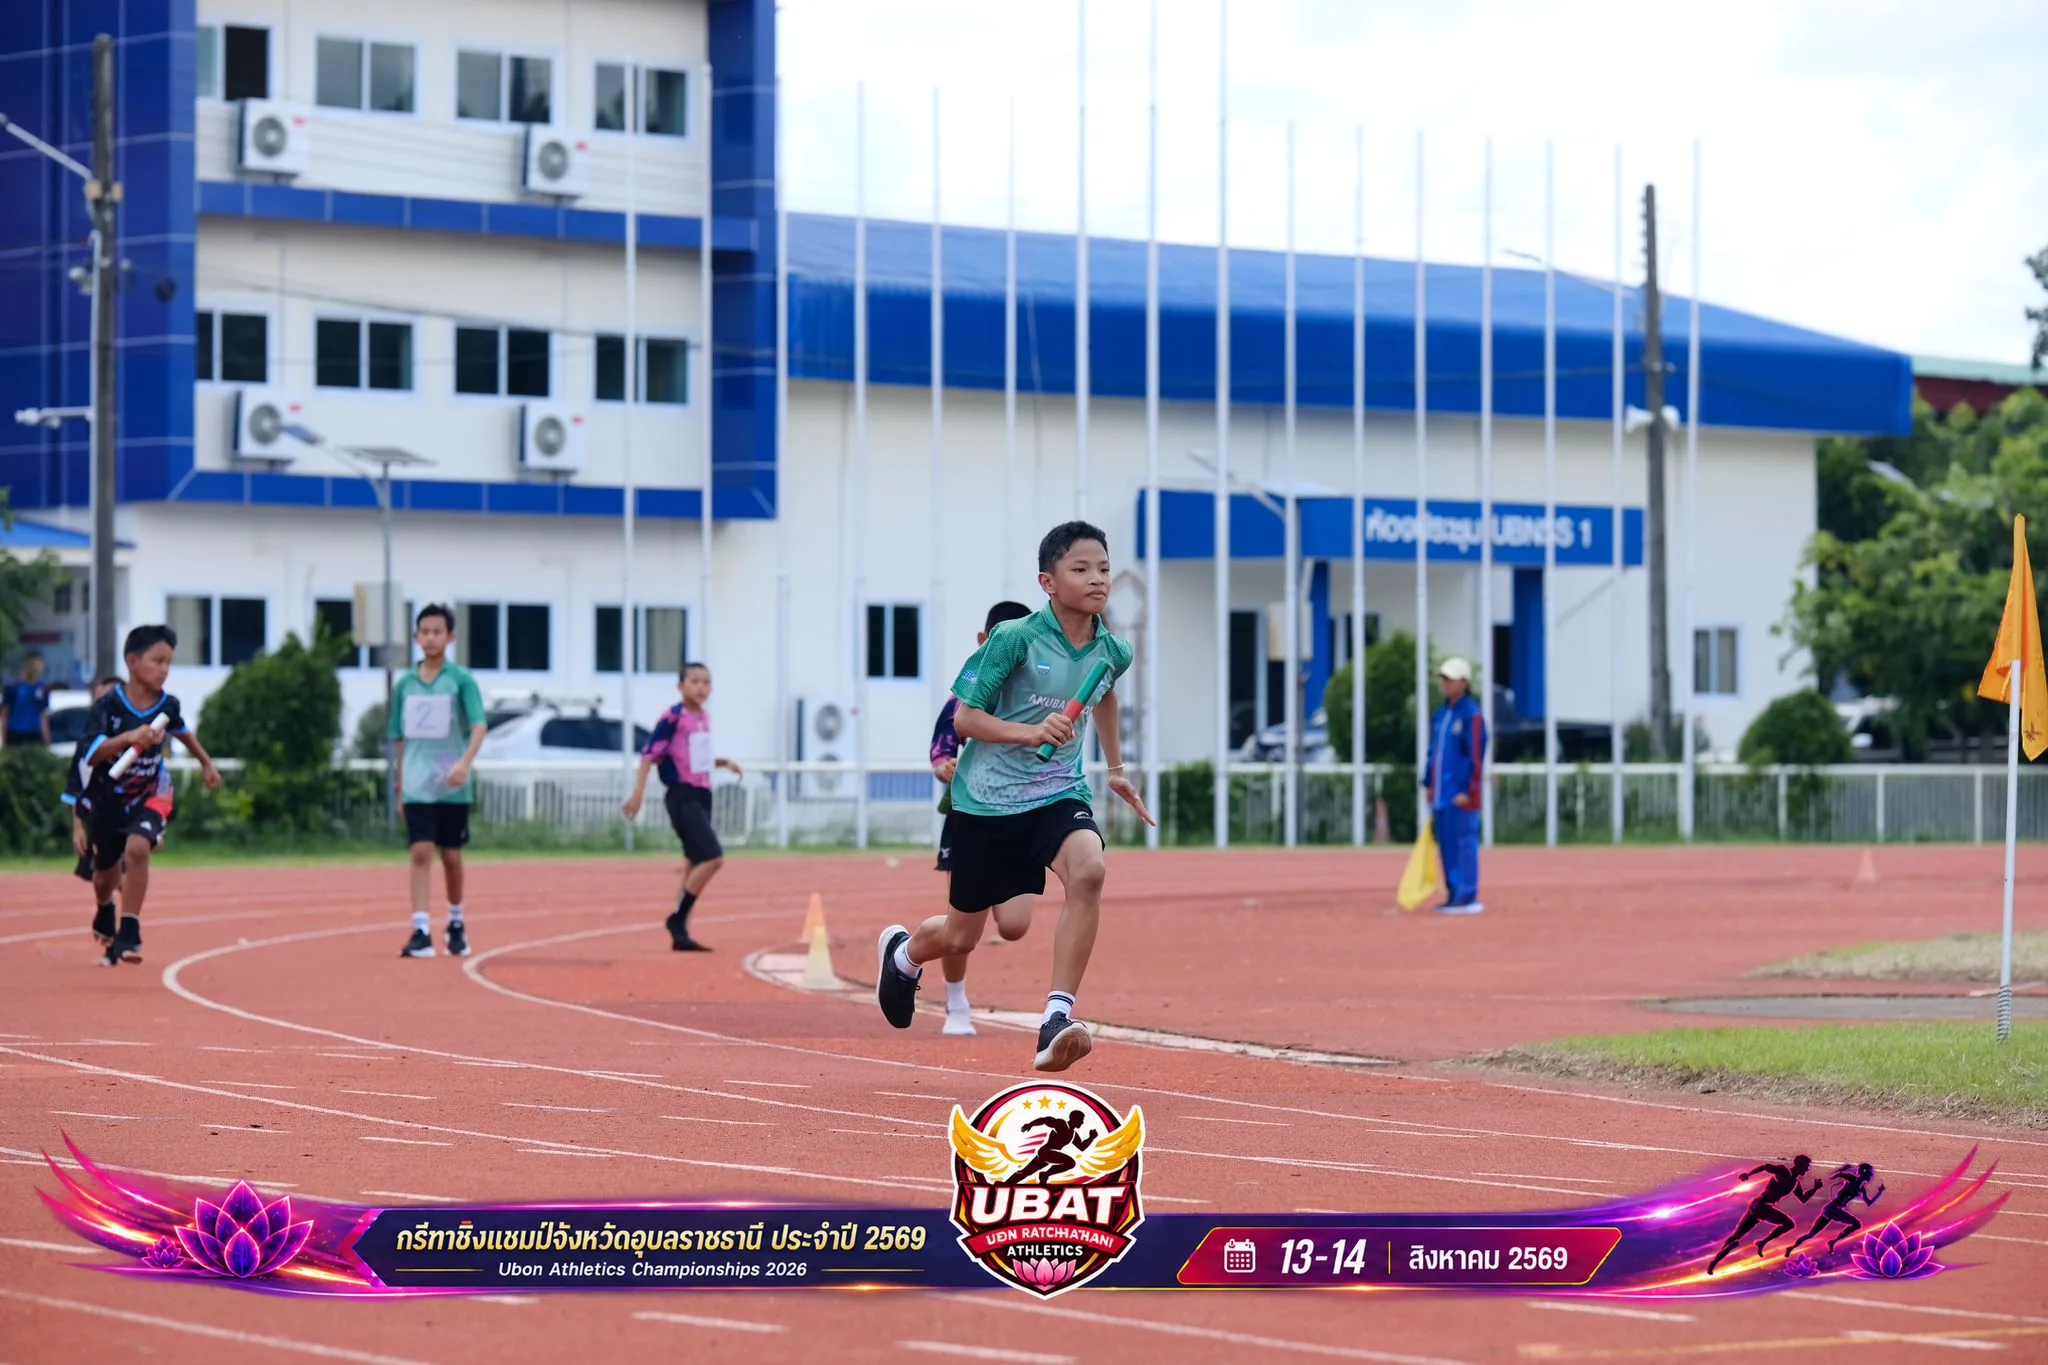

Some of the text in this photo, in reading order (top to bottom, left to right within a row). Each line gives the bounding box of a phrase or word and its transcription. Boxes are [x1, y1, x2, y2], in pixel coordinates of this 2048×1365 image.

[1578, 518, 1592, 549] 1
[1028, 694, 1068, 709] ANUBA
[415, 702, 437, 730] 2
